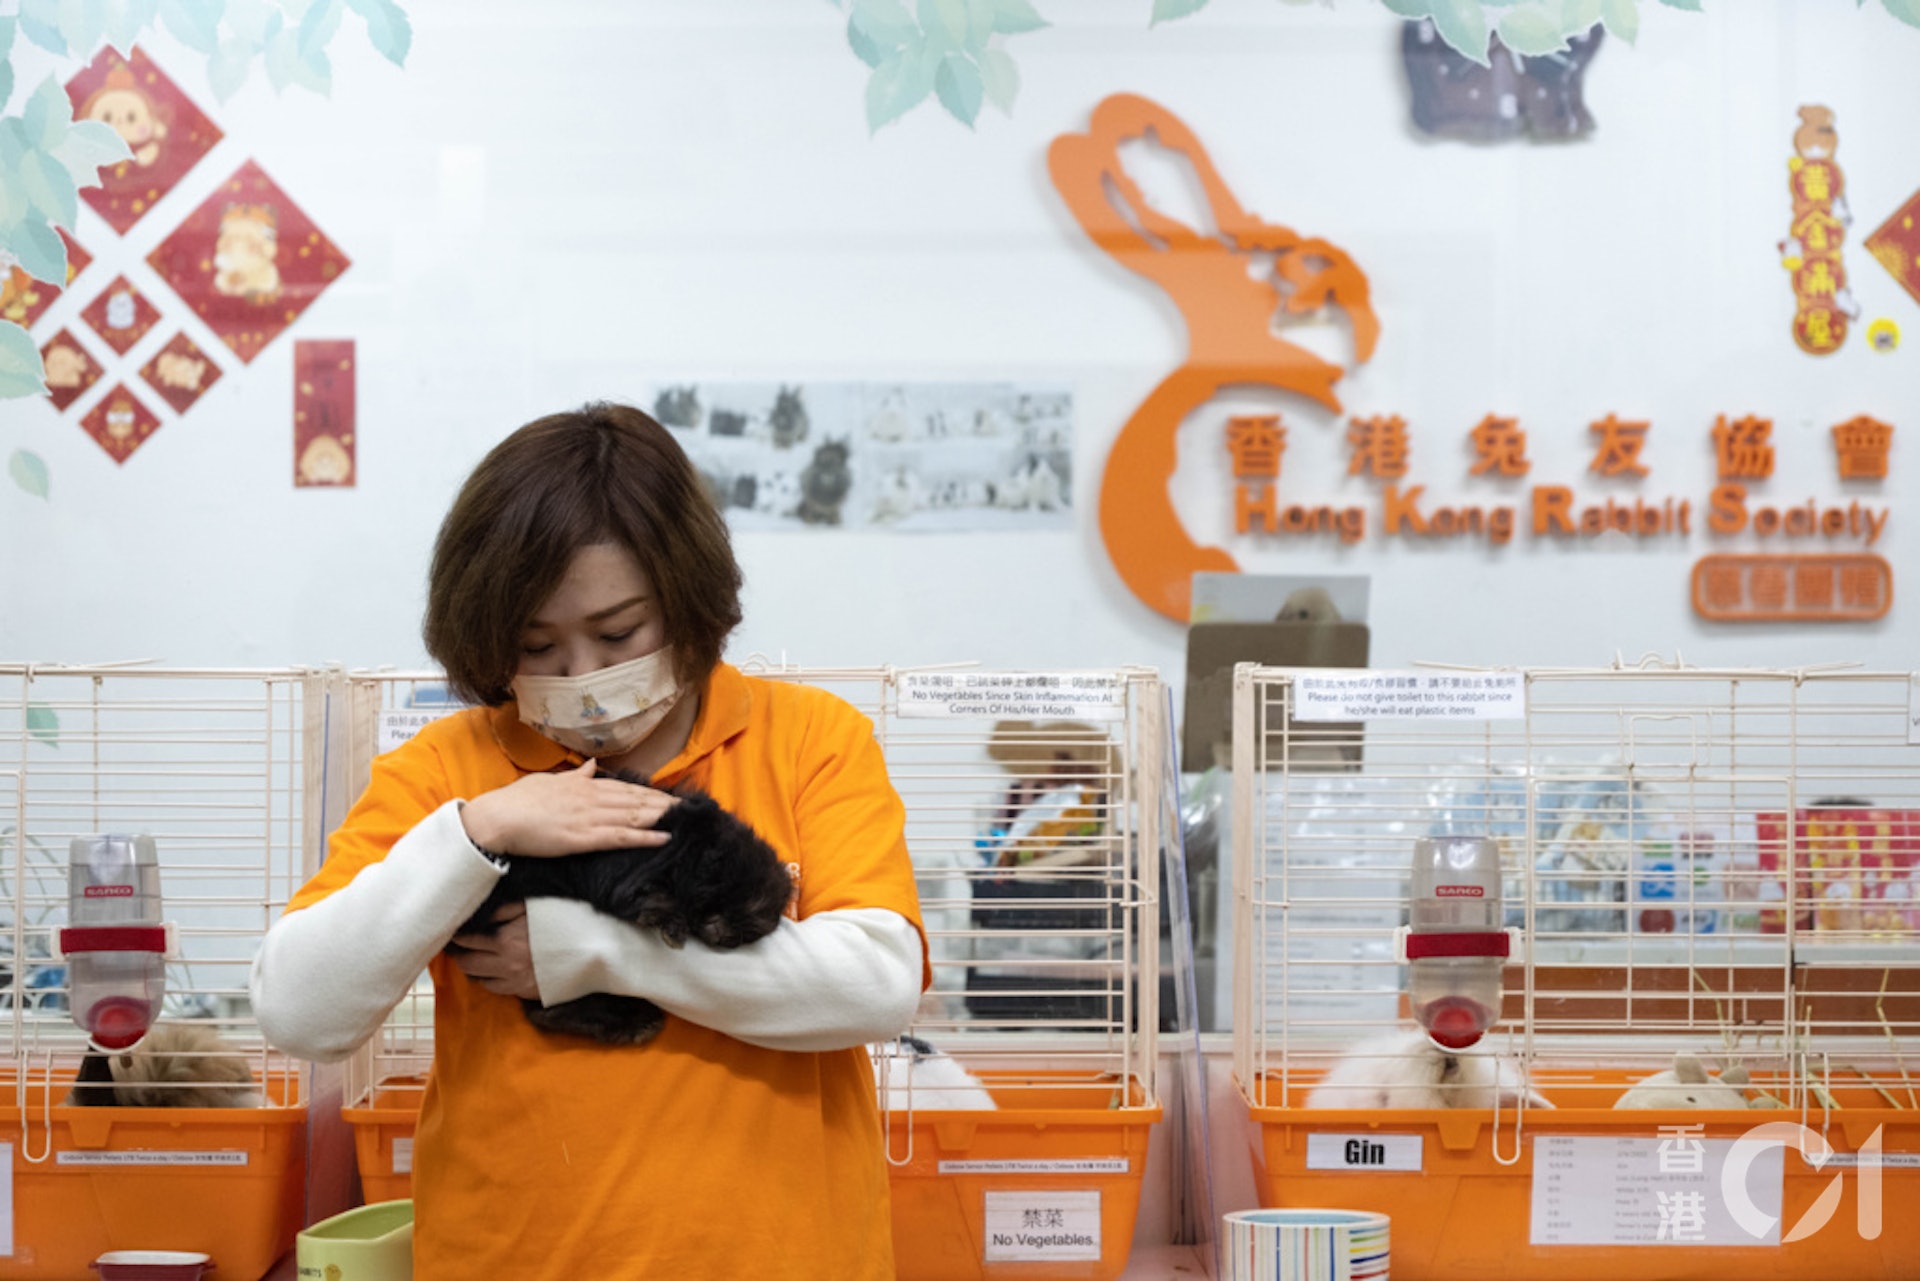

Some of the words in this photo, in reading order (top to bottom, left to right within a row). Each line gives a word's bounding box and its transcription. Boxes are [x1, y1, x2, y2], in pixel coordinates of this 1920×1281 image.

[1235, 484, 1364, 544] Hong
[1384, 484, 1514, 544] Kong
[1532, 485, 1690, 537] Rabbit
[1708, 482, 1889, 545] Society
[912, 690, 927, 700] No
[929, 690, 982, 702] Vegetables
[985, 691, 1010, 700] Since
[1013, 691, 1034, 701] Skin
[1036, 692, 1099, 702] Inflammation
[1102, 693, 1113, 702] At
[1308, 691, 1338, 701] Please
[1340, 692, 1353, 701] do
[1356, 693, 1372, 701] not
[1374, 693, 1395, 704] give
[1397, 692, 1422, 702] toilet
[1424, 692, 1435, 702] to
[1437, 692, 1454, 702] this
[1457, 692, 1486, 702] rabbit
[1488, 692, 1512, 702] since
[949, 703, 987, 714] Corners
[989, 704, 1003, 714] Of
[1004, 705, 1040, 715] His/Her
[1042, 705, 1075, 715] Mouth
[1345, 705, 1378, 715] he/she
[1380, 705, 1396, 715] will
[1398, 706, 1414, 715] eat
[1415, 705, 1447, 717] plastic
[1449, 705, 1475, 715] items
[1437, 887, 1482, 896] SANKO
[1345, 1139, 1384, 1165] Gin
[1022, 1208, 1065, 1228] 禁菜
[993, 1234, 1013, 1246] No
[1016, 1233, 1094, 1249] Vegetables
